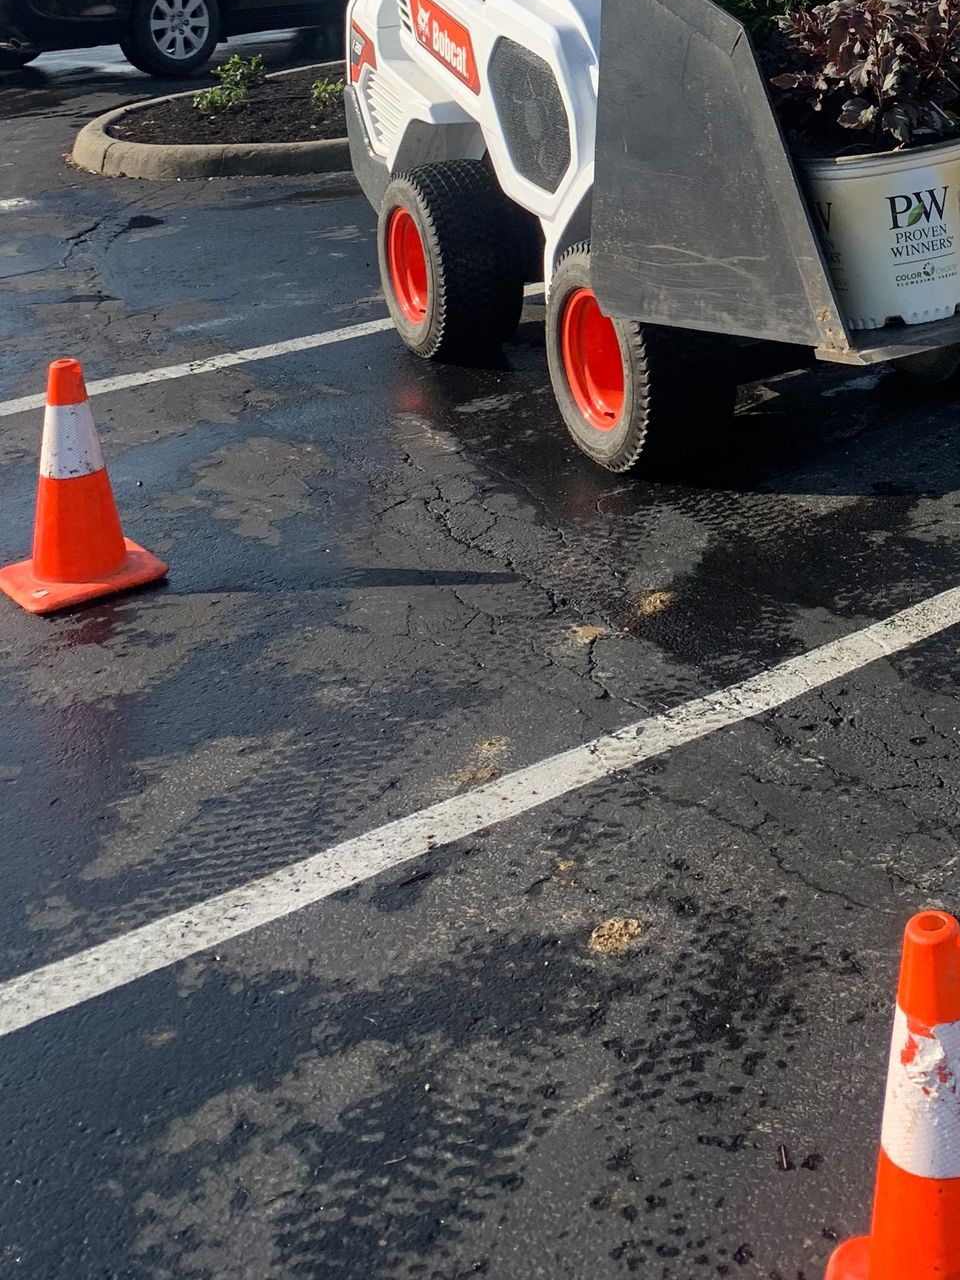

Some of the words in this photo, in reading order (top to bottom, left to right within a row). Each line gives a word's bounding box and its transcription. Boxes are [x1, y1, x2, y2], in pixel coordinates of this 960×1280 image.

[432, 20, 467, 78] Bobcat
[885, 185, 950, 231] PW
[895, 223, 948, 244] PROVEN
[890, 235, 954, 258] WINNERS
[895, 271, 923, 282] COLOR
